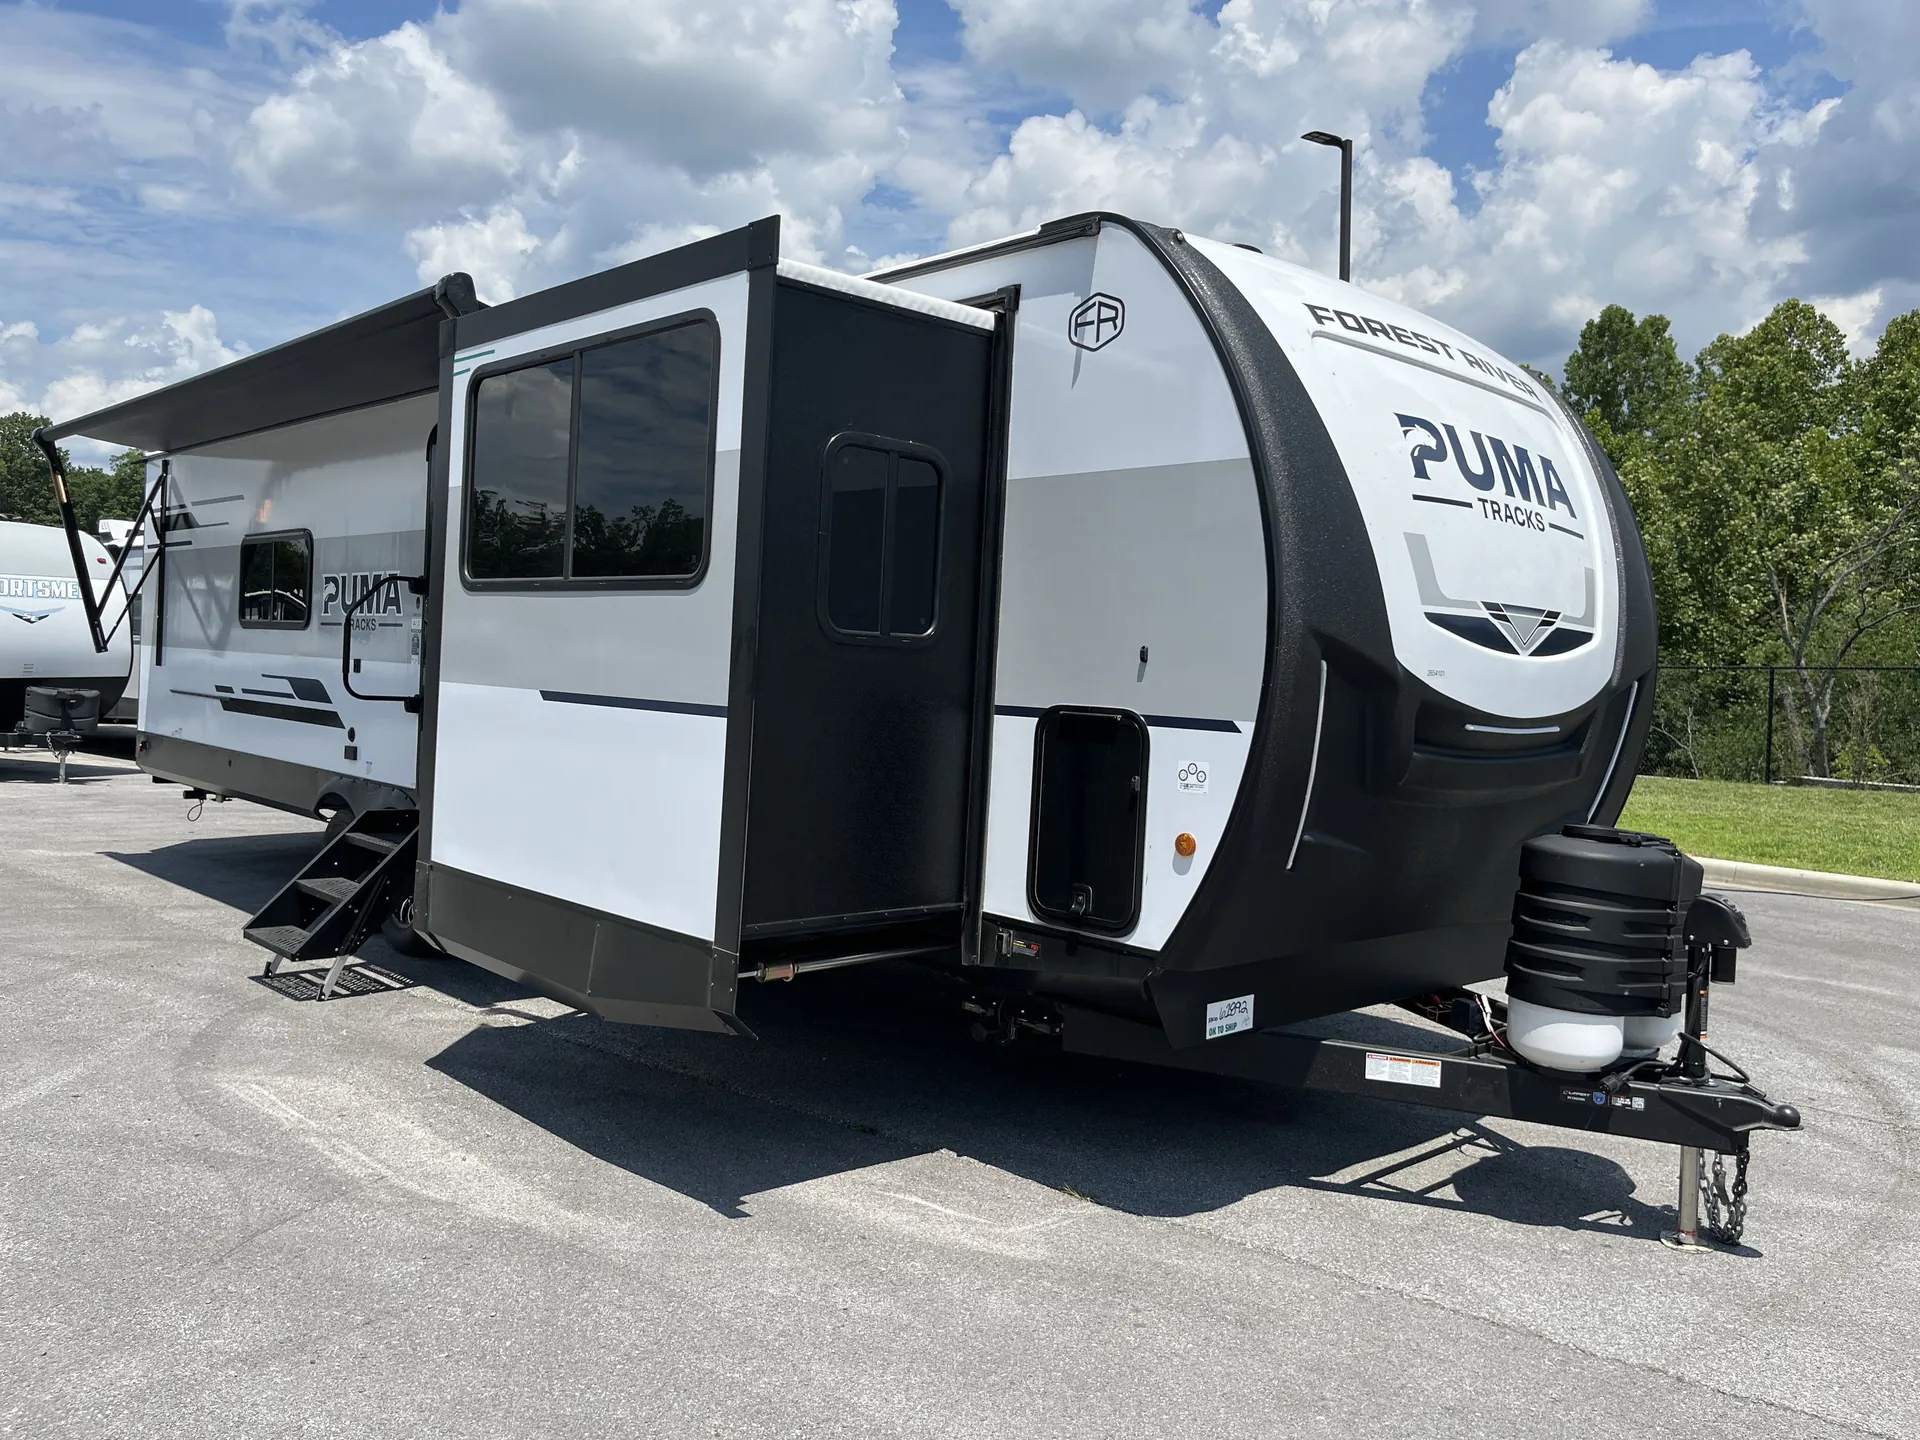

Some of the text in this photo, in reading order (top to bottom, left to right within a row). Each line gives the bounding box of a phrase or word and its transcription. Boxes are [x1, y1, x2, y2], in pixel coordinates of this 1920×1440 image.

[1301, 302, 1543, 403] FOREST RIVER
[1393, 412, 1578, 520] PUMA
[1477, 496, 1546, 532] TRACKS
[0, 577, 83, 600] ORTSME
[321, 571, 403, 616] PUMA
[345, 618, 377, 631] RACKS
[1208, 1021, 1238, 1037] OK TO SHIP
